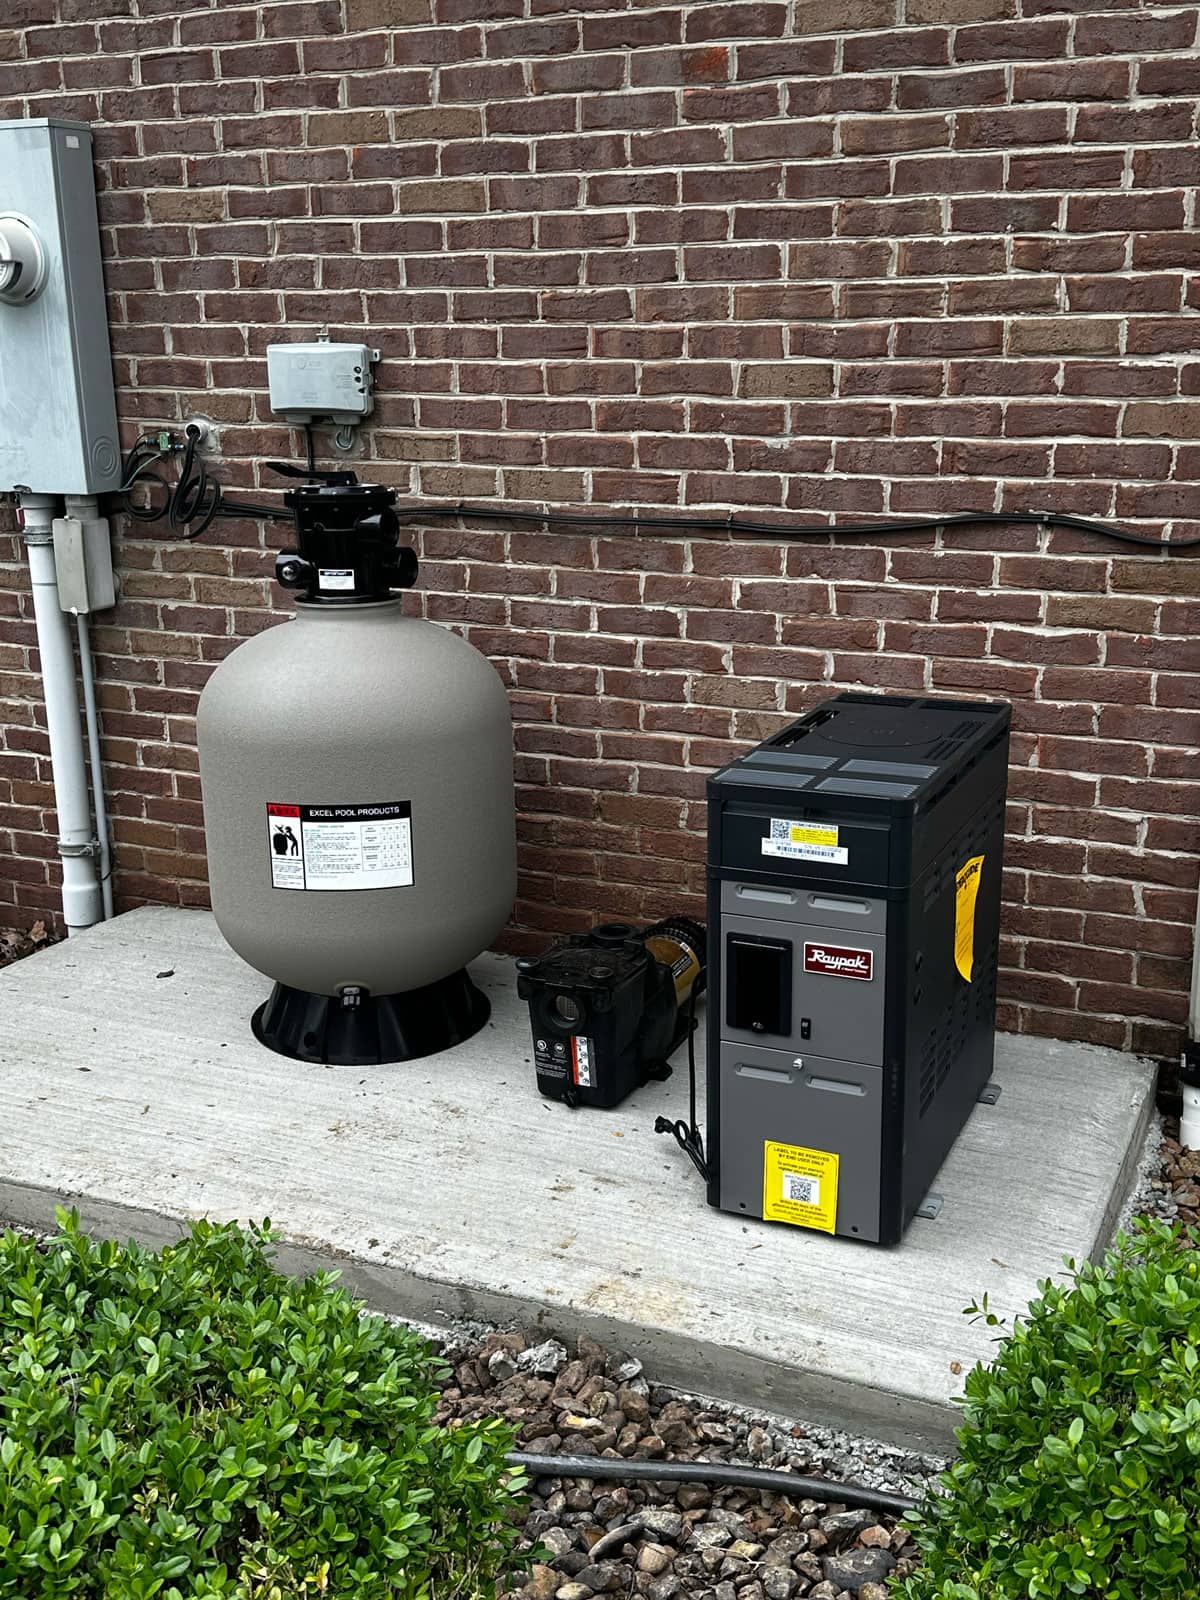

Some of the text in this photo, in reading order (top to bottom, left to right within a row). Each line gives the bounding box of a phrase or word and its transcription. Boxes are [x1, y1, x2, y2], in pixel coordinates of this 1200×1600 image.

[309, 809, 334, 817] EXCEL
[335, 808, 357, 817] POOL
[357, 806, 400, 816] PRODUCTS
[807, 949, 869, 970] Raypak
